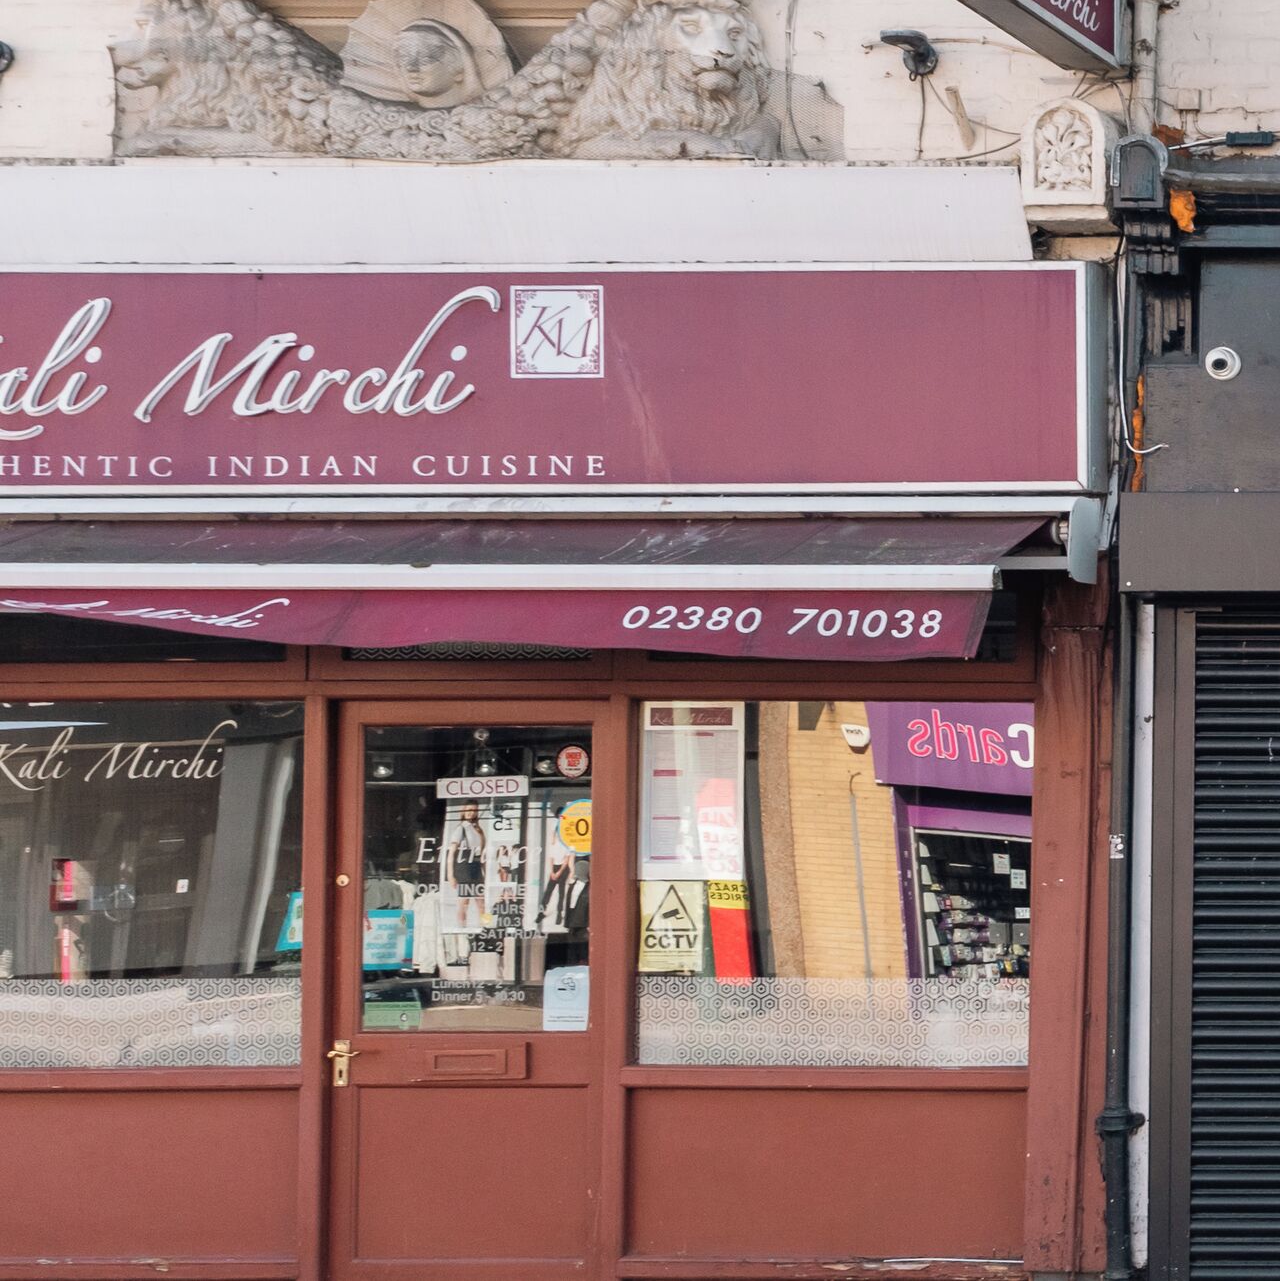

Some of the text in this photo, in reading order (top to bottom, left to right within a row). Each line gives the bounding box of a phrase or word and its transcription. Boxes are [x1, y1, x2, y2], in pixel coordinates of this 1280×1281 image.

[0, 285, 501, 440] ali Mirchi
[207, 455, 378, 477] INDIAN
[412, 454, 607, 477] CUISINE
[622, 605, 942, 638] 02380 701038
[0, 719, 238, 791] Kali Mirchi
[446, 778, 519, 796] CLOSED
[416, 837, 543, 864] Entrace
[417, 884, 486, 897] OPING
[499, 917, 522, 927] 10.3
[644, 934, 698, 949] CCTV
[432, 991, 473, 1002] Dinner
